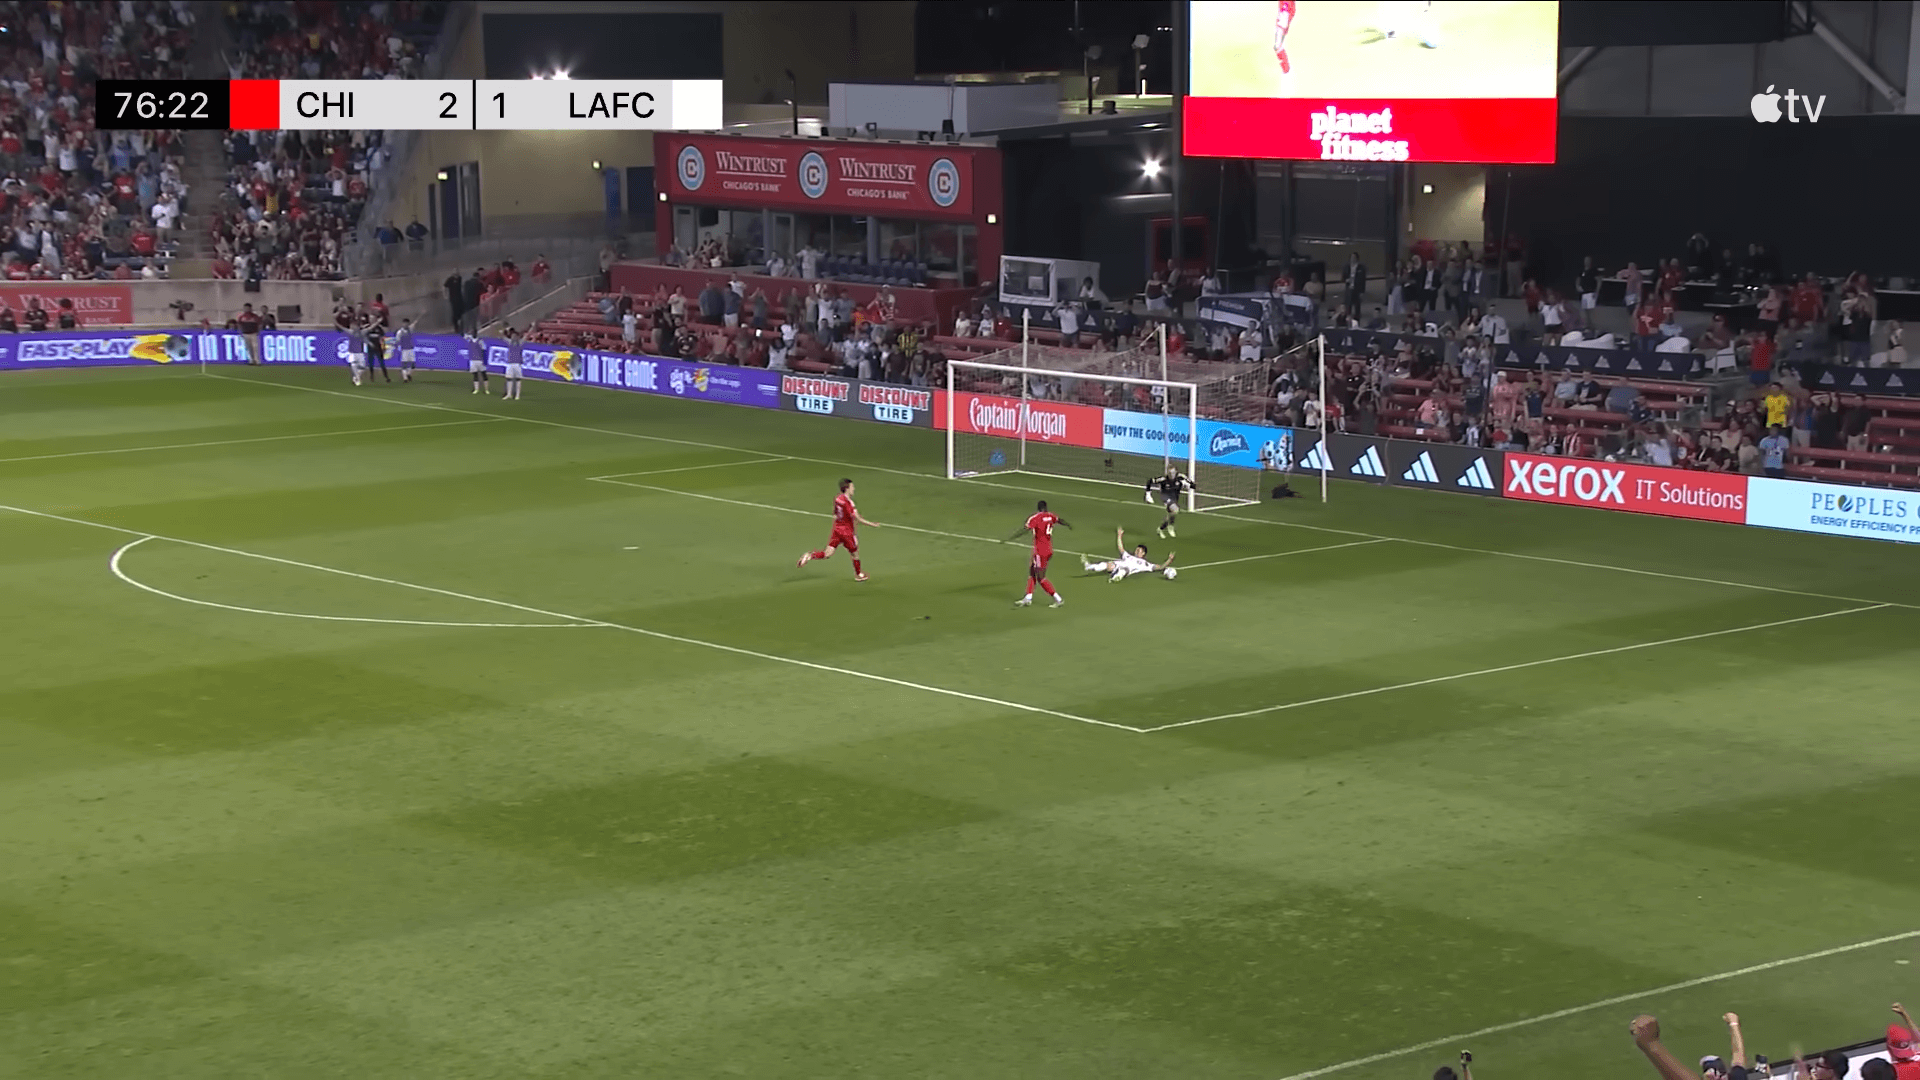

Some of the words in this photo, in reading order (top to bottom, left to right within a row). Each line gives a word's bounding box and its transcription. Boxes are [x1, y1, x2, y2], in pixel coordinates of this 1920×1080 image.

[1310, 105, 1393, 140] planet
[1320, 132, 1409, 161] fitness
[715, 151, 787, 174] WINTRUST
[839, 157, 916, 180] WINTRUST
[722, 180, 760, 191] CHICAGO'S
[761, 182, 780, 193] BANK
[846, 188, 886, 199] CHICAGO'S
[887, 189, 907, 200] BANK
[19, 294, 122, 309] WINRUST
[198, 334, 218, 361] IN
[221, 334, 250, 361] TH
[263, 335, 317, 362] GAME
[587, 354, 600, 382] IN
[601, 356, 622, 385] THE
[624, 360, 658, 390] GAME
[782, 375, 849, 402] DISCOUNT
[859, 384, 930, 411] DISCOUNT
[801, 397, 829, 411] TIRE
[879, 407, 908, 420] TIRE
[969, 397, 1016, 433] Captain
[1015, 402, 1067, 440] Morgan
[1104, 424, 1127, 438] ENJOY
[1129, 427, 1144, 439] THE
[1508, 459, 1626, 504] xerox
[1635, 479, 1656, 500] IT
[1659, 482, 1744, 510] Solutions
[1810, 515, 1849, 528] ENERGY
[1849, 519, 1908, 533] EFFICIENCY
